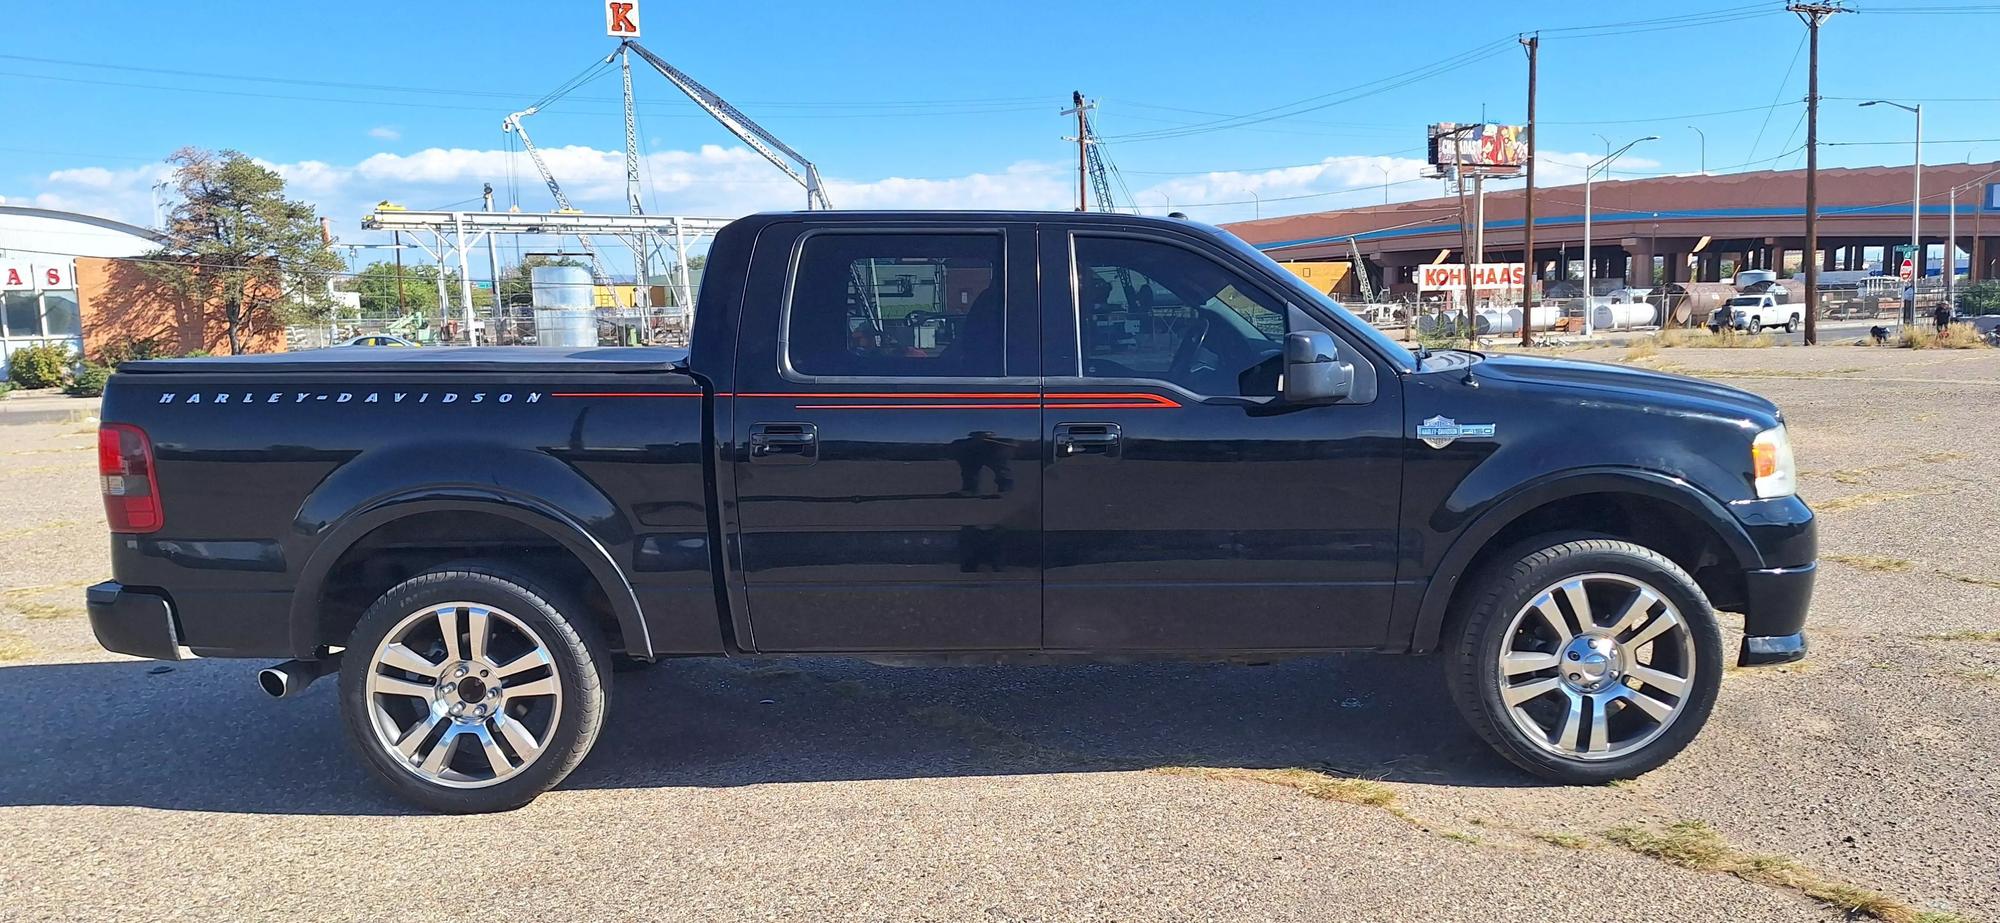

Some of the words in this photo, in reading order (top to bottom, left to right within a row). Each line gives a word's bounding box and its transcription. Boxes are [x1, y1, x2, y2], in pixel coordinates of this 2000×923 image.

[610, 2, 636, 32] K
[1442, 139, 1476, 155] CHEADAS
[159, 393, 541, 404] HARLEY-DAVIDSON
